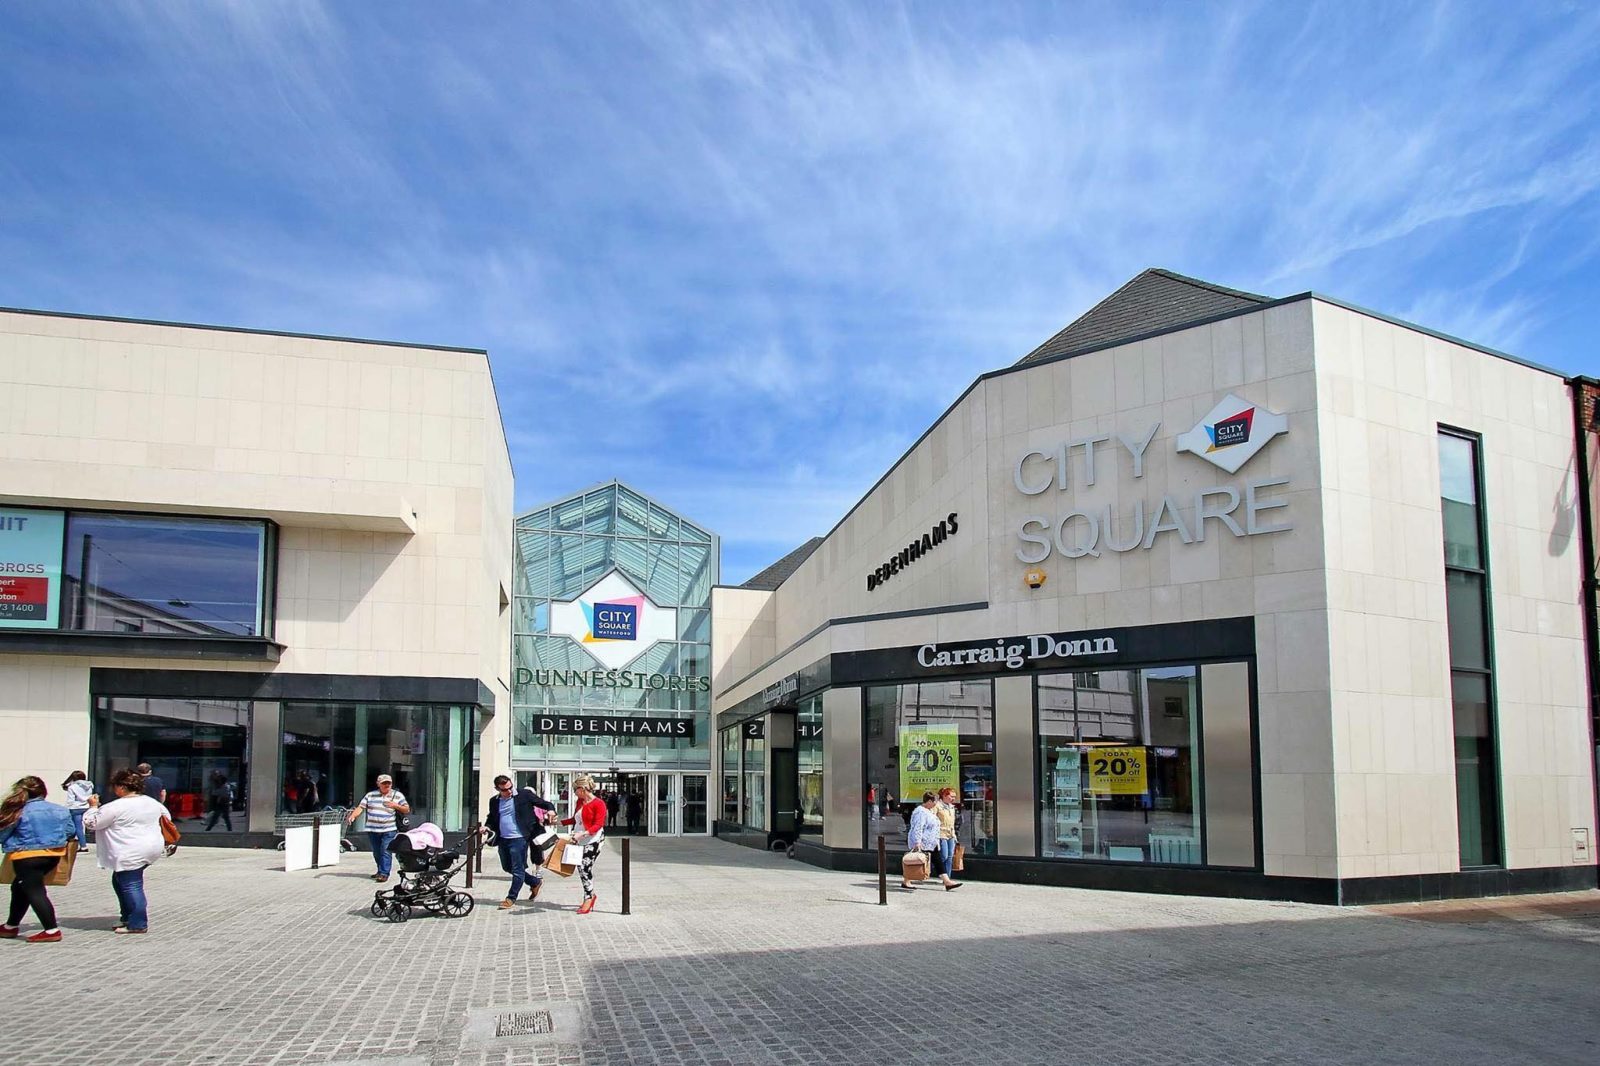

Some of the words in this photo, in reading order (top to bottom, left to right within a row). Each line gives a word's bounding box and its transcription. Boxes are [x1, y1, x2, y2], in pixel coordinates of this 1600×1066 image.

[1218, 424, 1244, 435] CITY
[1218, 432, 1244, 440] SQUARE
[1014, 422, 1161, 495] CITY
[1015, 475, 1294, 565] SQUARE
[867, 513, 959, 591] DEBENHAMS
[11, 604, 34, 612] 1400
[598, 610, 631, 622] CITY
[598, 622, 631, 630] SQUARE
[917, 637, 1025, 669] Carraig
[1027, 634, 1118, 660] Donn
[541, 718, 686, 734] DEBENHAMS
[907, 749, 953, 772] 20%
[1094, 758, 1141, 776] 20%
